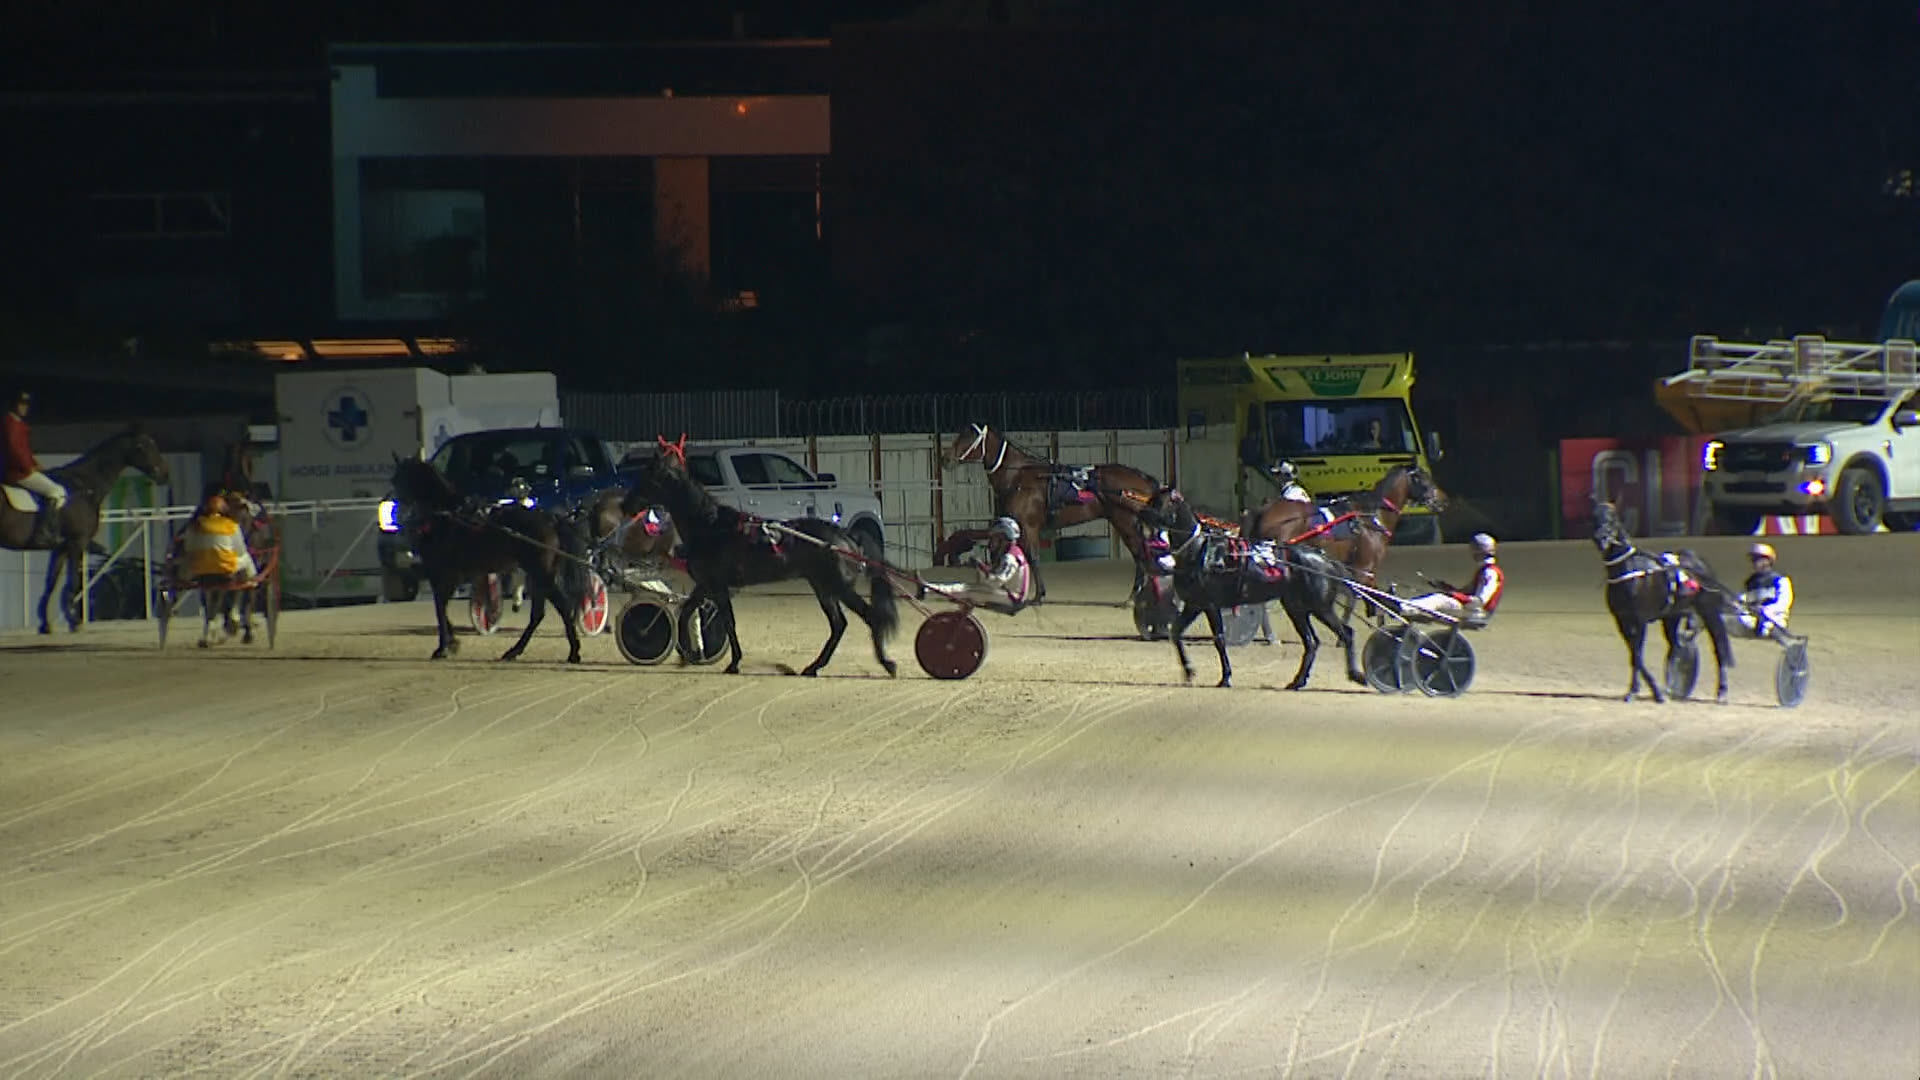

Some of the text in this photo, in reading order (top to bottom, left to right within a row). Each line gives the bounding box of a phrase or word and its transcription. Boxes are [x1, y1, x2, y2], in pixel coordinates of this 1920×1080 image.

[1305, 368, 1361, 381] ST JOHN
[290, 463, 396, 478] HORSE AMBULAN
